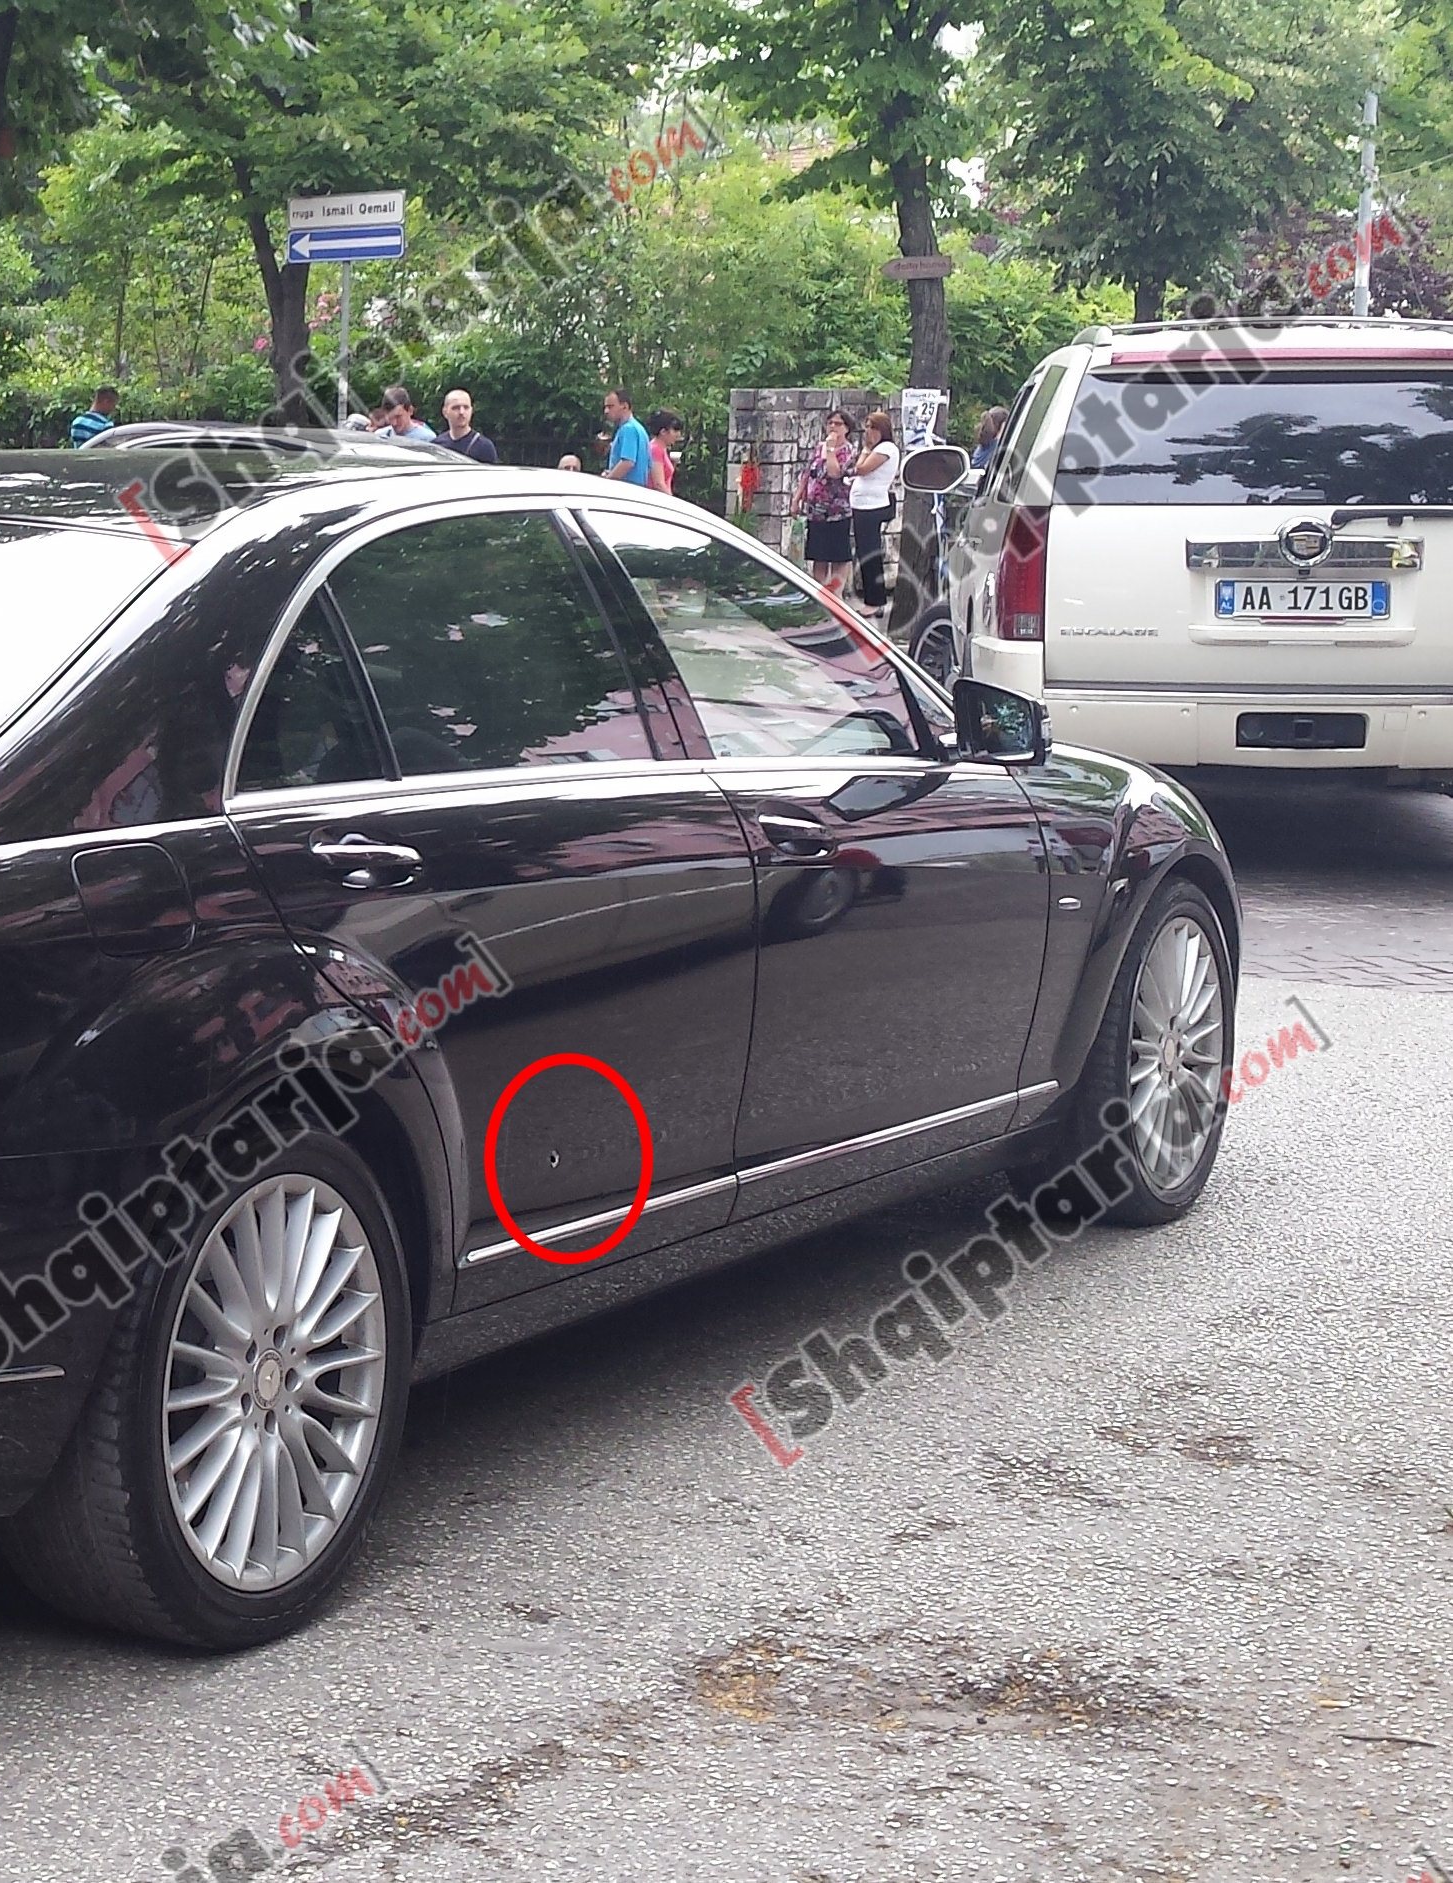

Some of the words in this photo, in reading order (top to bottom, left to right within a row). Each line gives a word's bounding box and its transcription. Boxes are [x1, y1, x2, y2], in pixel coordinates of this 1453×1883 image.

[292, 210, 314, 220] rruga
[322, 203, 353, 217] Ismail
[359, 200, 396, 215] Qemali
[1241, 586, 1273, 611] AA
